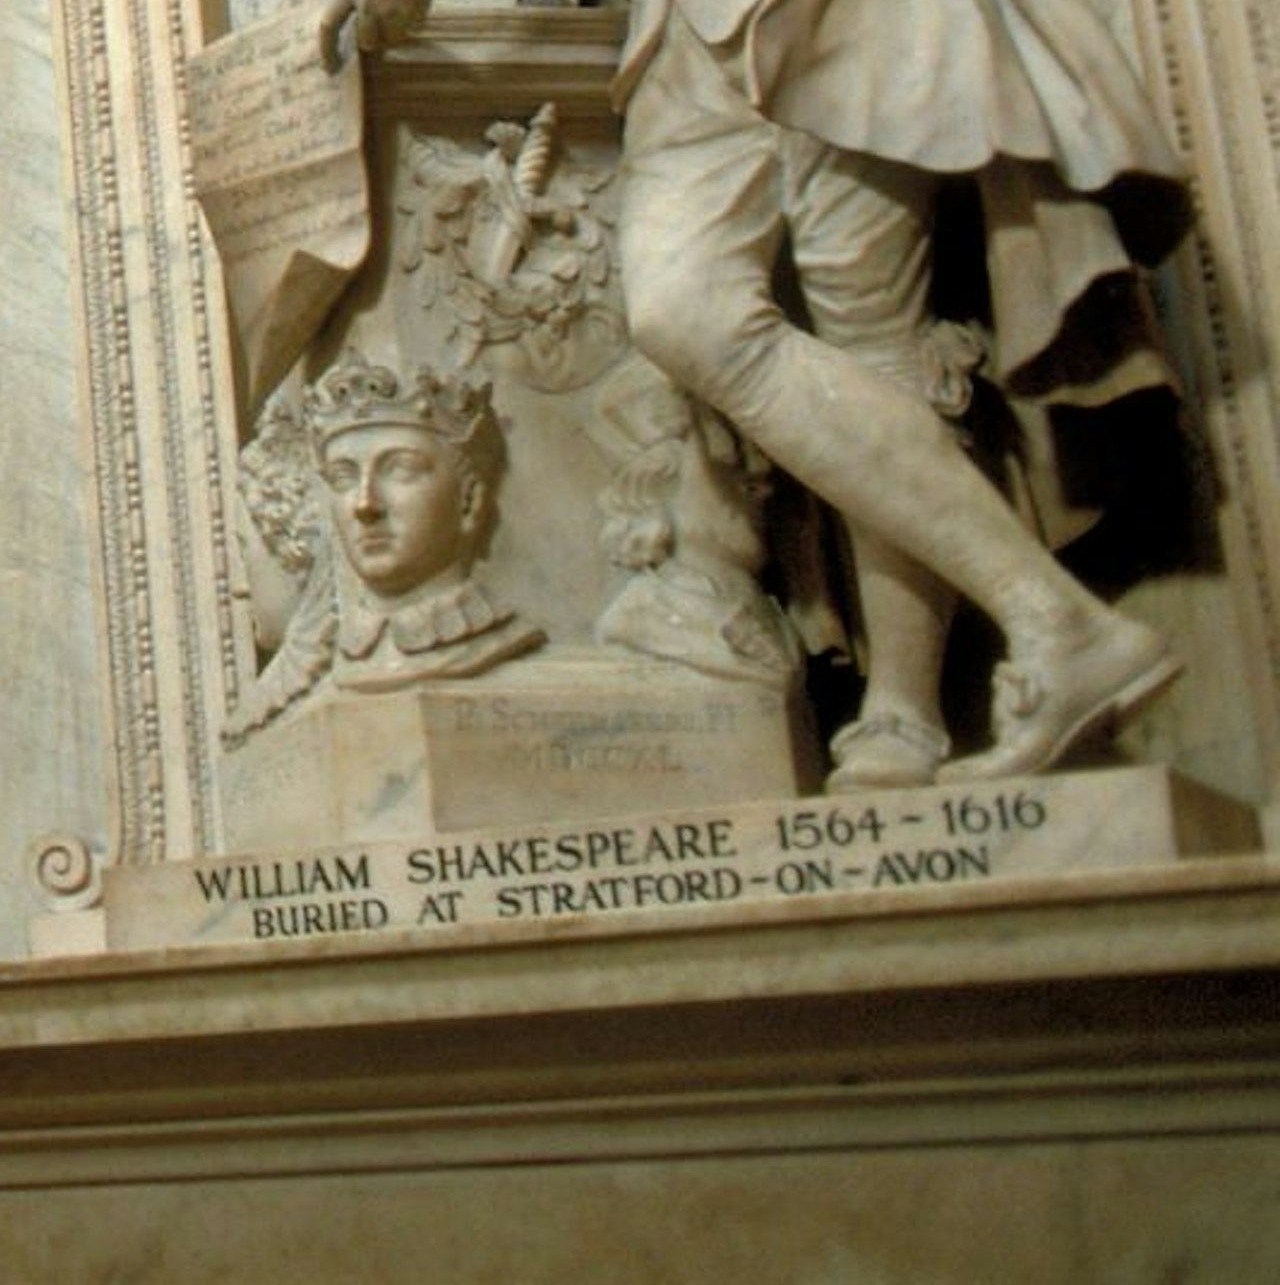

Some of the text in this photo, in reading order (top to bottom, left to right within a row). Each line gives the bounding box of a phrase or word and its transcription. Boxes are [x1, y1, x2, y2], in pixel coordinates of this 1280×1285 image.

[193, 855, 371, 903] WILLIAM
[406, 819, 737, 884] SHAKESPEARE
[776, 806, 887, 851] 1564
[940, 791, 1048, 836] 1616
[252, 897, 389, 940] BURIED
[414, 891, 465, 926] AT
